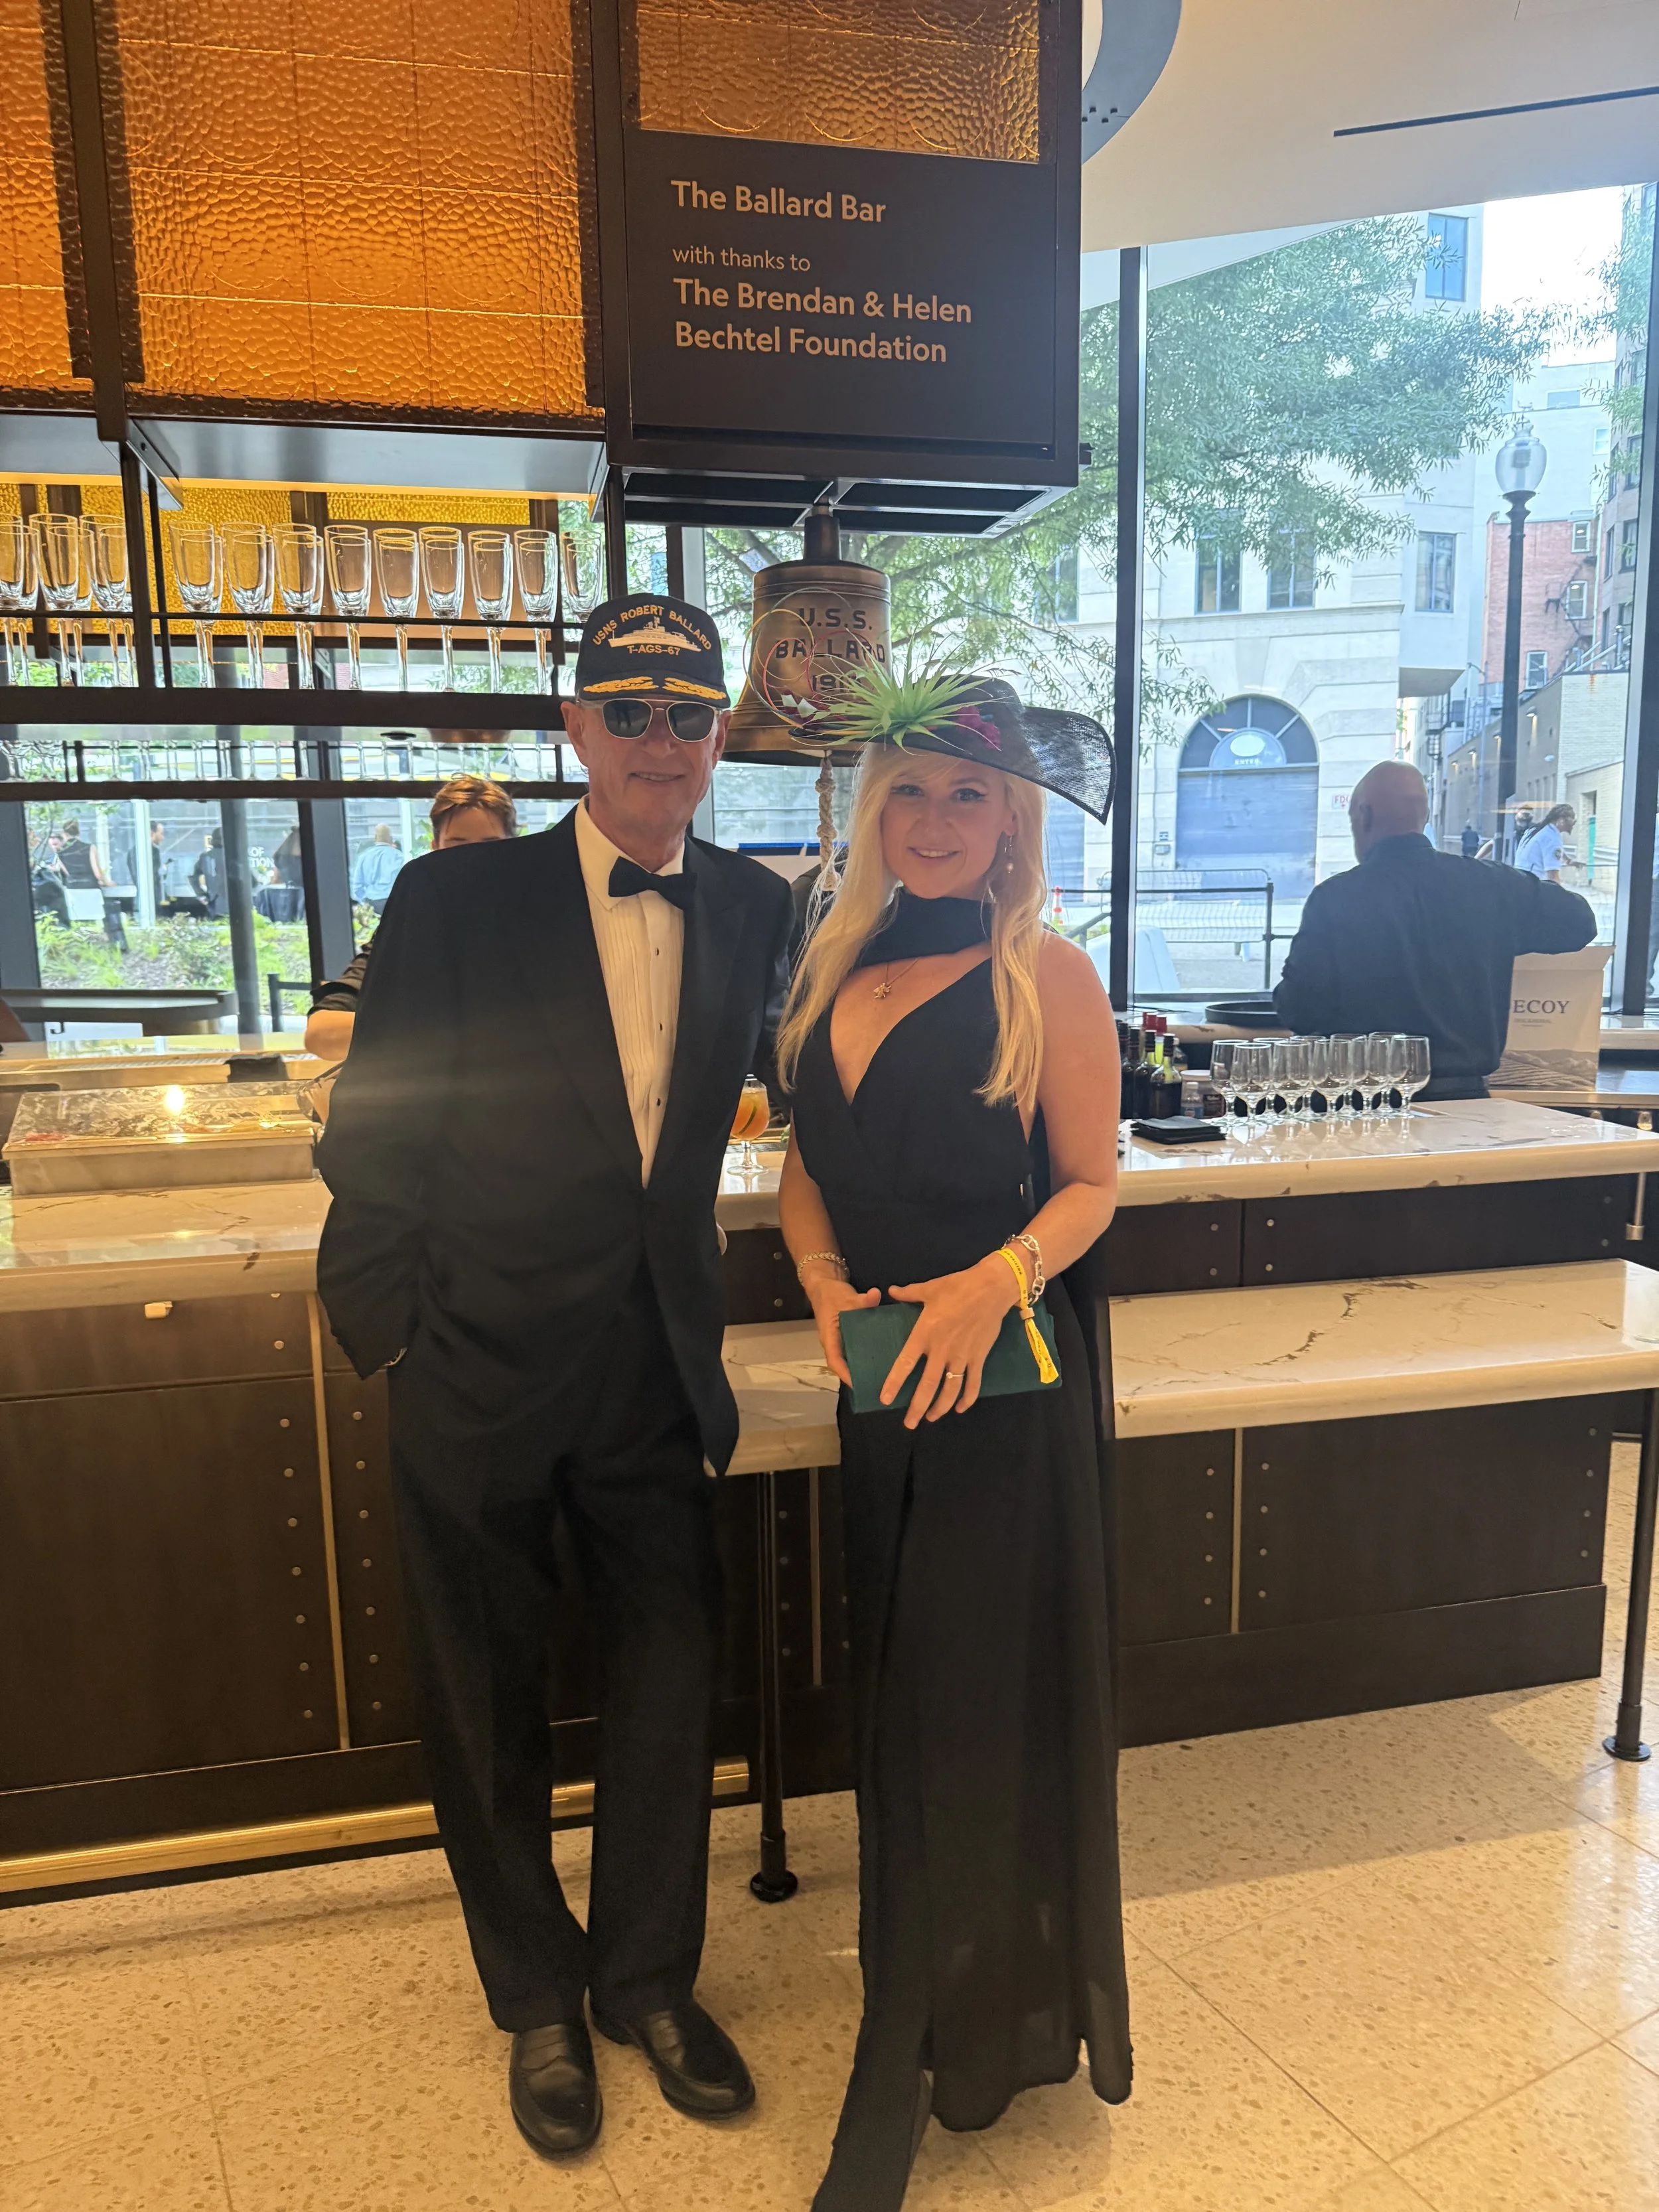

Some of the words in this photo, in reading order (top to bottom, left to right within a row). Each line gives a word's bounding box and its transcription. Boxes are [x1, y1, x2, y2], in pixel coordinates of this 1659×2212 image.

[670, 180, 727, 210] The
[736, 185, 832, 218] Ballard
[841, 194, 887, 222] Bar
[672, 246, 715, 265] with
[720, 247, 785, 269] thanks
[790, 254, 811, 271] to
[673, 277, 729, 307] The
[738, 282, 855, 315] Brendan
[863, 291, 885, 317] &
[893, 293, 972, 323] Helen
[676, 321, 781, 352] Bechtel
[790, 328, 947, 362] Foundation
[593, 620, 618, 646] USNS
[620, 605, 664, 623] ROBERT
[668, 611, 712, 650] BALLARD
[798, 607, 873, 630] U.S.S.
[626, 644, 681, 656] T-AGS-67
